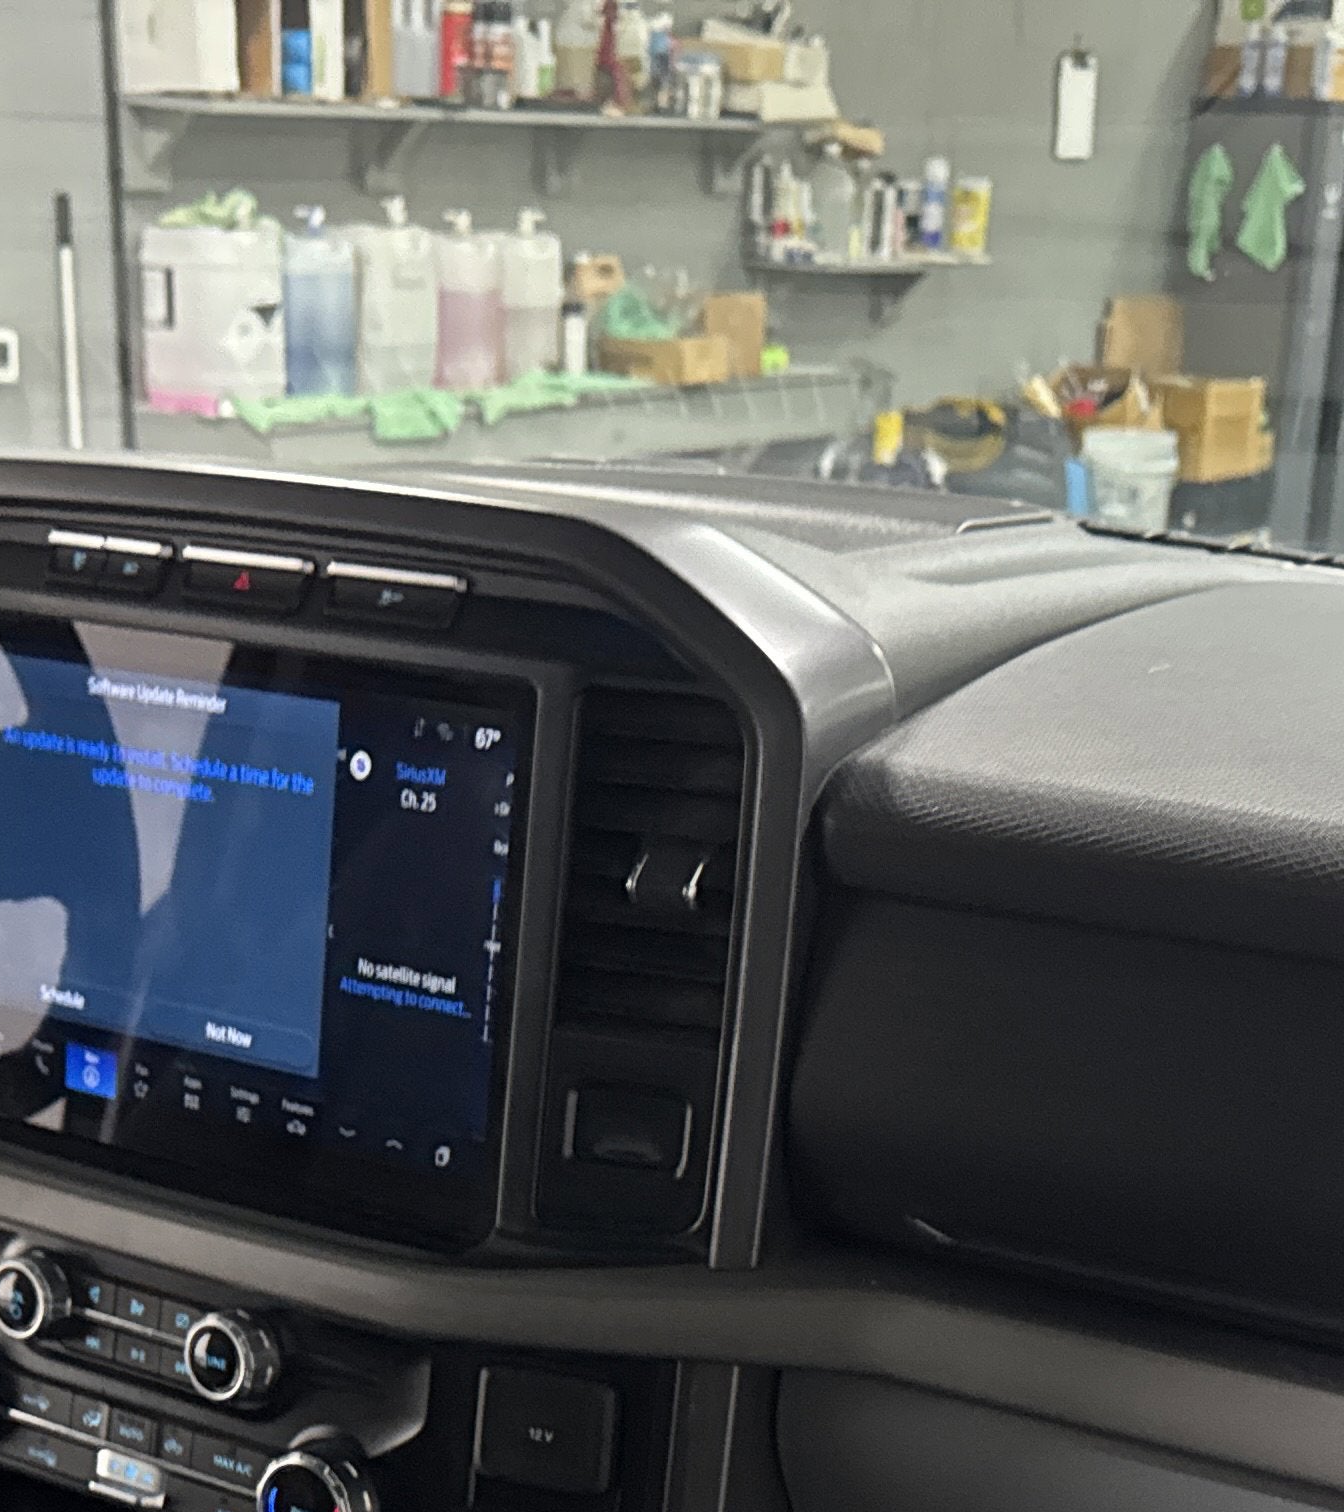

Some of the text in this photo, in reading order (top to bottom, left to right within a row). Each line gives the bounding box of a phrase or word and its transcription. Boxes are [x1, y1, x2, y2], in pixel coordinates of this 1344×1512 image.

[88, 676, 227, 714] Software Update Reminder
[22, 730, 65, 752] update
[169, 749, 227, 780] Schedule
[240, 763, 269, 788] time
[271, 767, 289, 791] for
[291, 772, 314, 796] the
[395, 761, 447, 786] SiriusXM
[340, 976, 403, 1006] Attempting
[405, 990, 418, 1005] to
[358, 958, 456, 994] No satellite signal
[206, 1021, 252, 1049] Not Now
[213, 1453, 235, 1471] MAX
